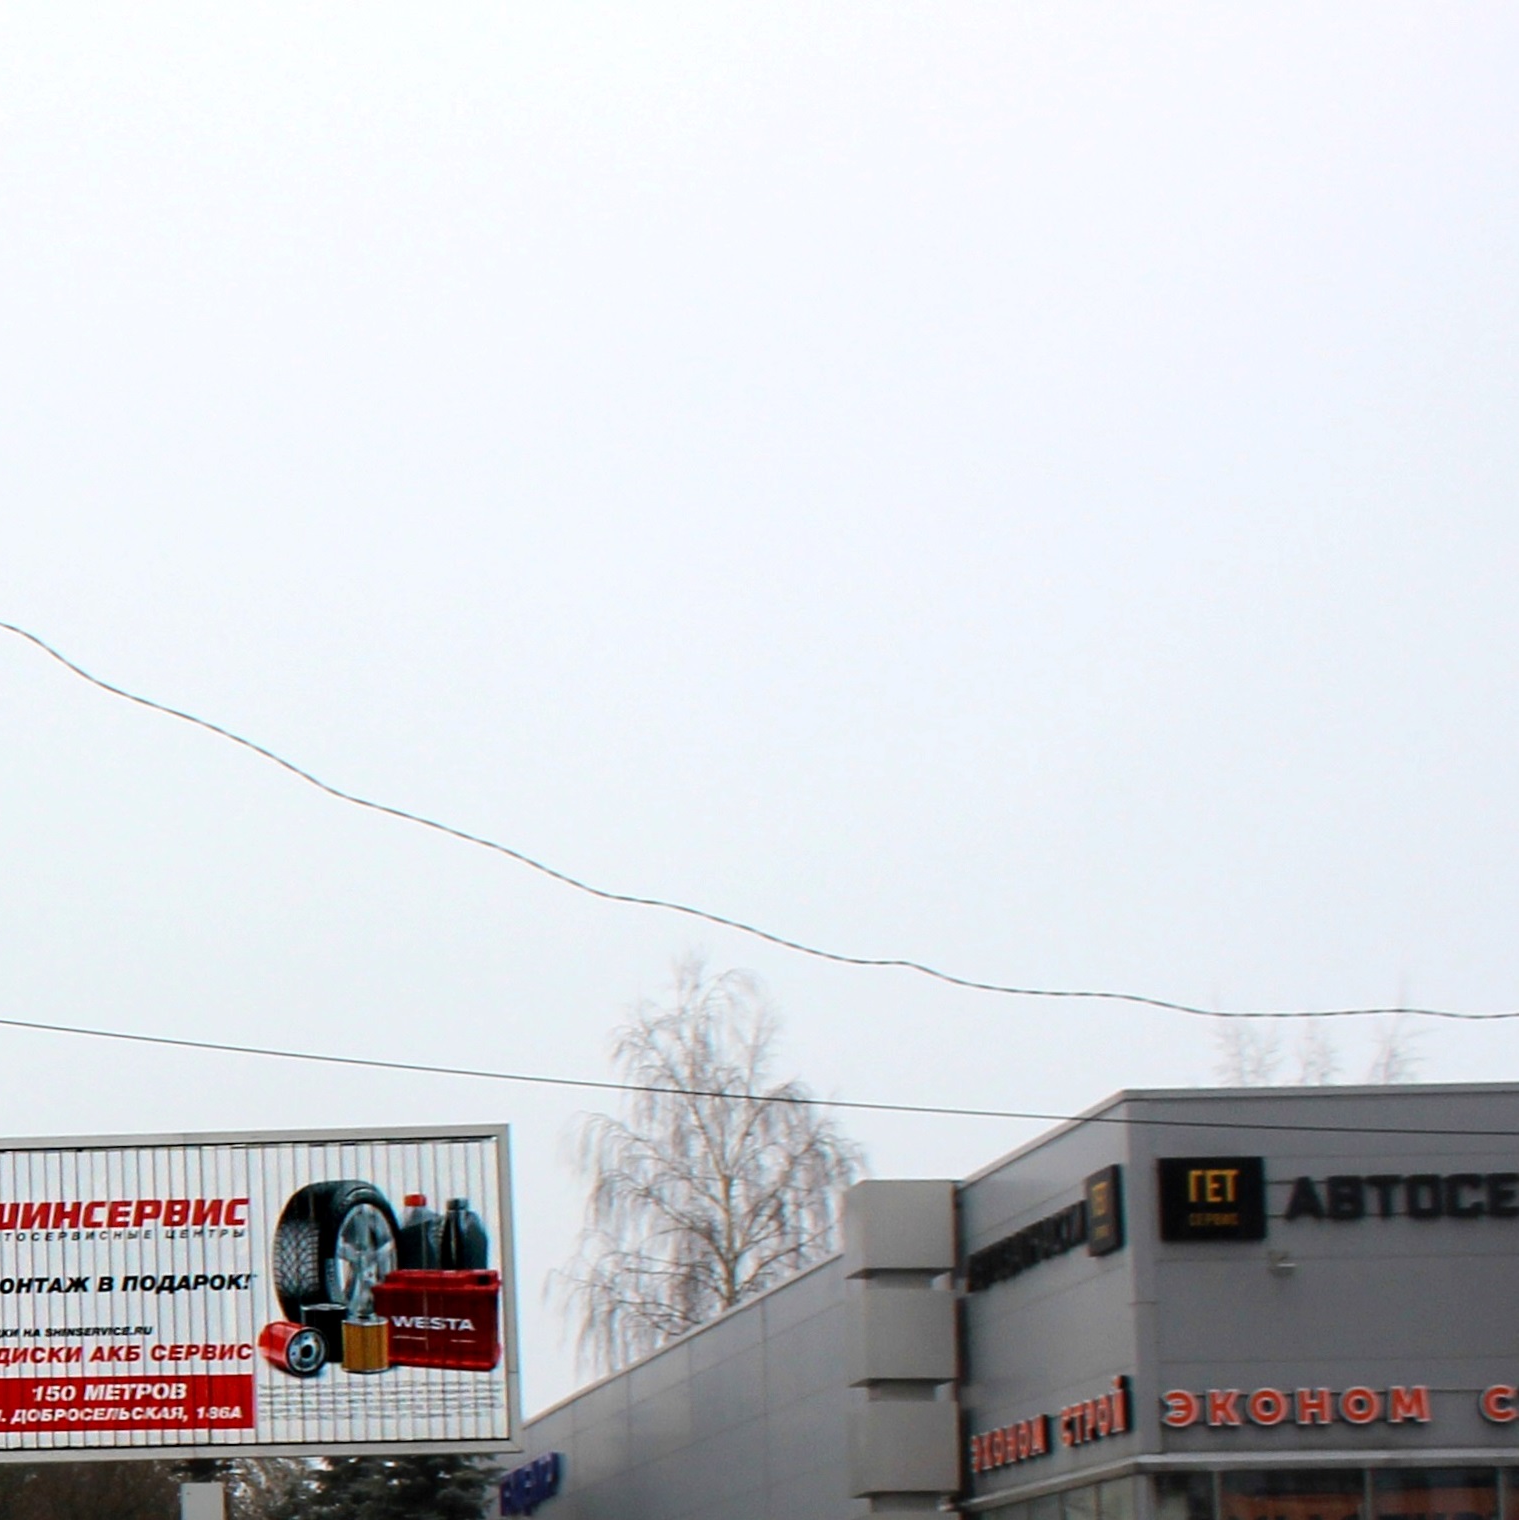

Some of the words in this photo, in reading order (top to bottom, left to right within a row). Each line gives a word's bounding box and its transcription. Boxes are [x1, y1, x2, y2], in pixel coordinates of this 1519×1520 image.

[1188, 1169, 1240, 1202] ГЕТ
[165, 1228, 246, 1240] ЦЕНТРЫ
[97, 1276, 115, 1293] В
[22, 1328, 41, 1338] НА
[44, 1325, 153, 1338] SHINSERVICE.RU
[390, 1314, 476, 1332] WESTA
[89, 1344, 141, 1363] АКБ
[149, 1342, 254, 1362] СЕРВИС
[31, 1384, 77, 1402] 150
[83, 1382, 188, 1401] МЕТРОВ
[10, 1406, 189, 1424] ДОБРОСЕЛЬСКАЯ,
[1164, 1386, 1432, 1426] ЭКОНОМ
